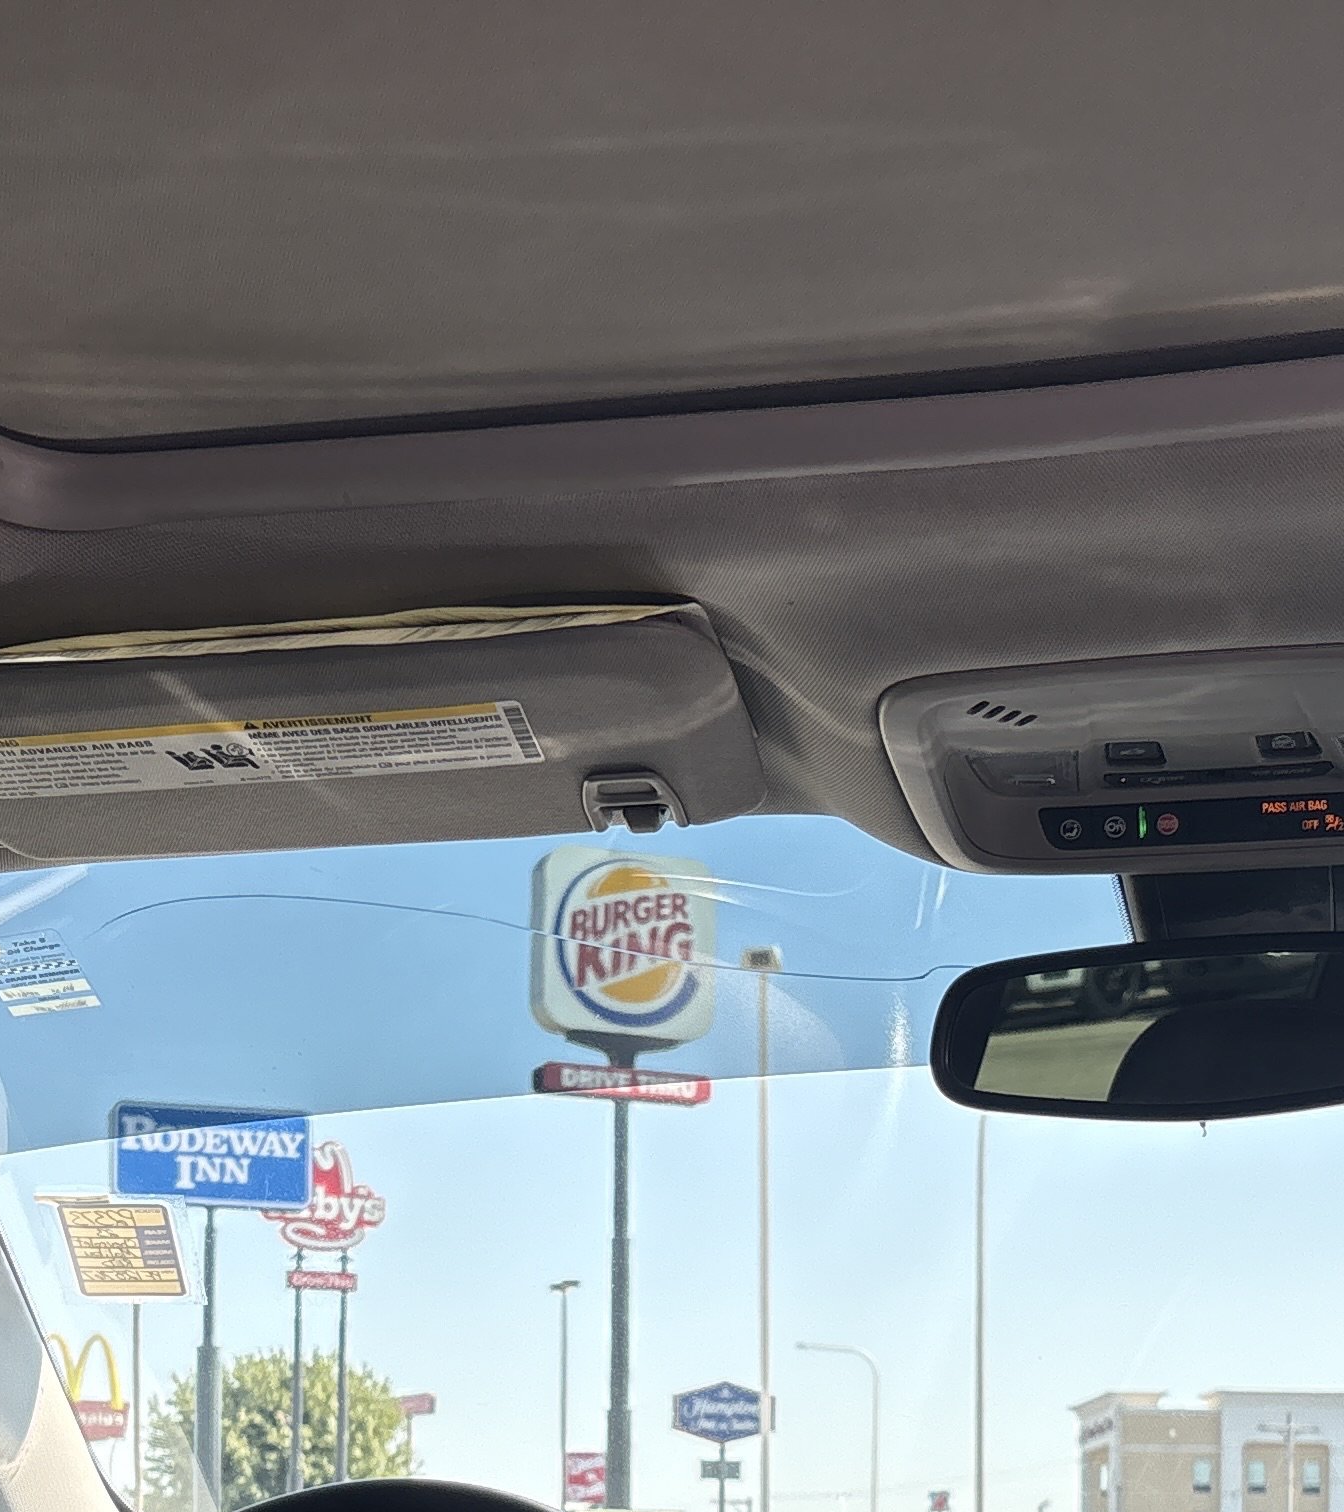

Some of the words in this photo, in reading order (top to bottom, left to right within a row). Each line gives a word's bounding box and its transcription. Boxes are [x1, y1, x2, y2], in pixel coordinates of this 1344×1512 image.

[261, 715, 373, 729] AVERTISSEMENT
[20, 744, 88, 756] ADVANCED
[92, 742, 114, 751] AIR
[117, 740, 153, 750] BAGS
[1261, 801, 1287, 813] PASS
[1289, 801, 1306, 812] AIR
[1307, 799, 1328, 811] BAG
[1301, 819, 1320, 831] OFF
[571, 892, 690, 941] BURGER
[23, 943, 60, 952] Change
[575, 921, 694, 988] KING
[561, 1068, 631, 1089] DRIVE
[120, 1112, 304, 1160] RODEWAY
[175, 1158, 252, 1190] INN
[314, 1185, 385, 1230] by's
